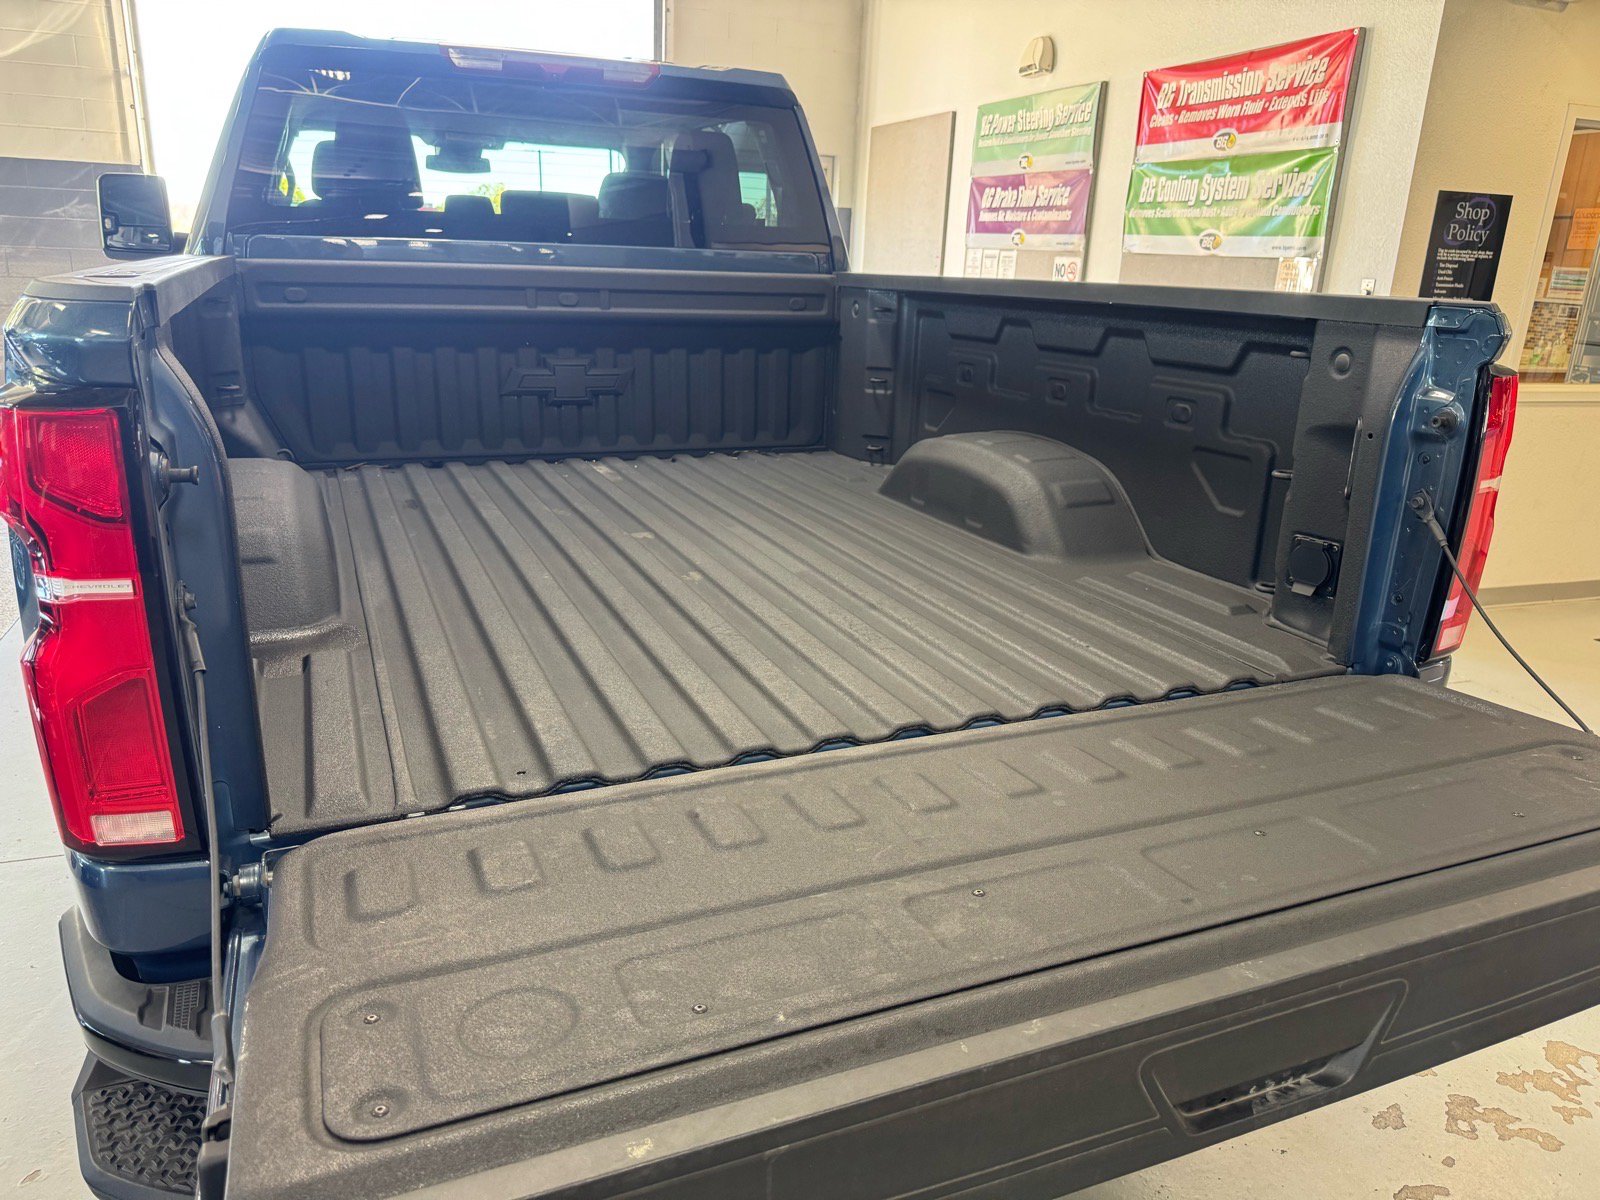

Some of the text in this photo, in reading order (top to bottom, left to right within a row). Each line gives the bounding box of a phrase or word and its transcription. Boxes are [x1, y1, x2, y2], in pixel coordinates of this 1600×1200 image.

[1157, 54, 1331, 110] BG Transmission Service
[990, 113, 1016, 135] Power
[1017, 107, 1055, 133] Steering
[1055, 101, 1093, 126] Service
[1178, 108, 1217, 125] Removes
[1217, 103, 1241, 119] Worn
[1240, 99, 1264, 116] Fluid
[1268, 92, 1308, 112] Extends
[991, 186, 1018, 209] Brake
[1037, 184, 1070, 207] Service
[1139, 168, 1317, 207] BG Cooling System Service
[1455, 202, 1490, 225] Shop
[1448, 224, 1490, 246] Policy
[1054, 263, 1066, 278] NO
